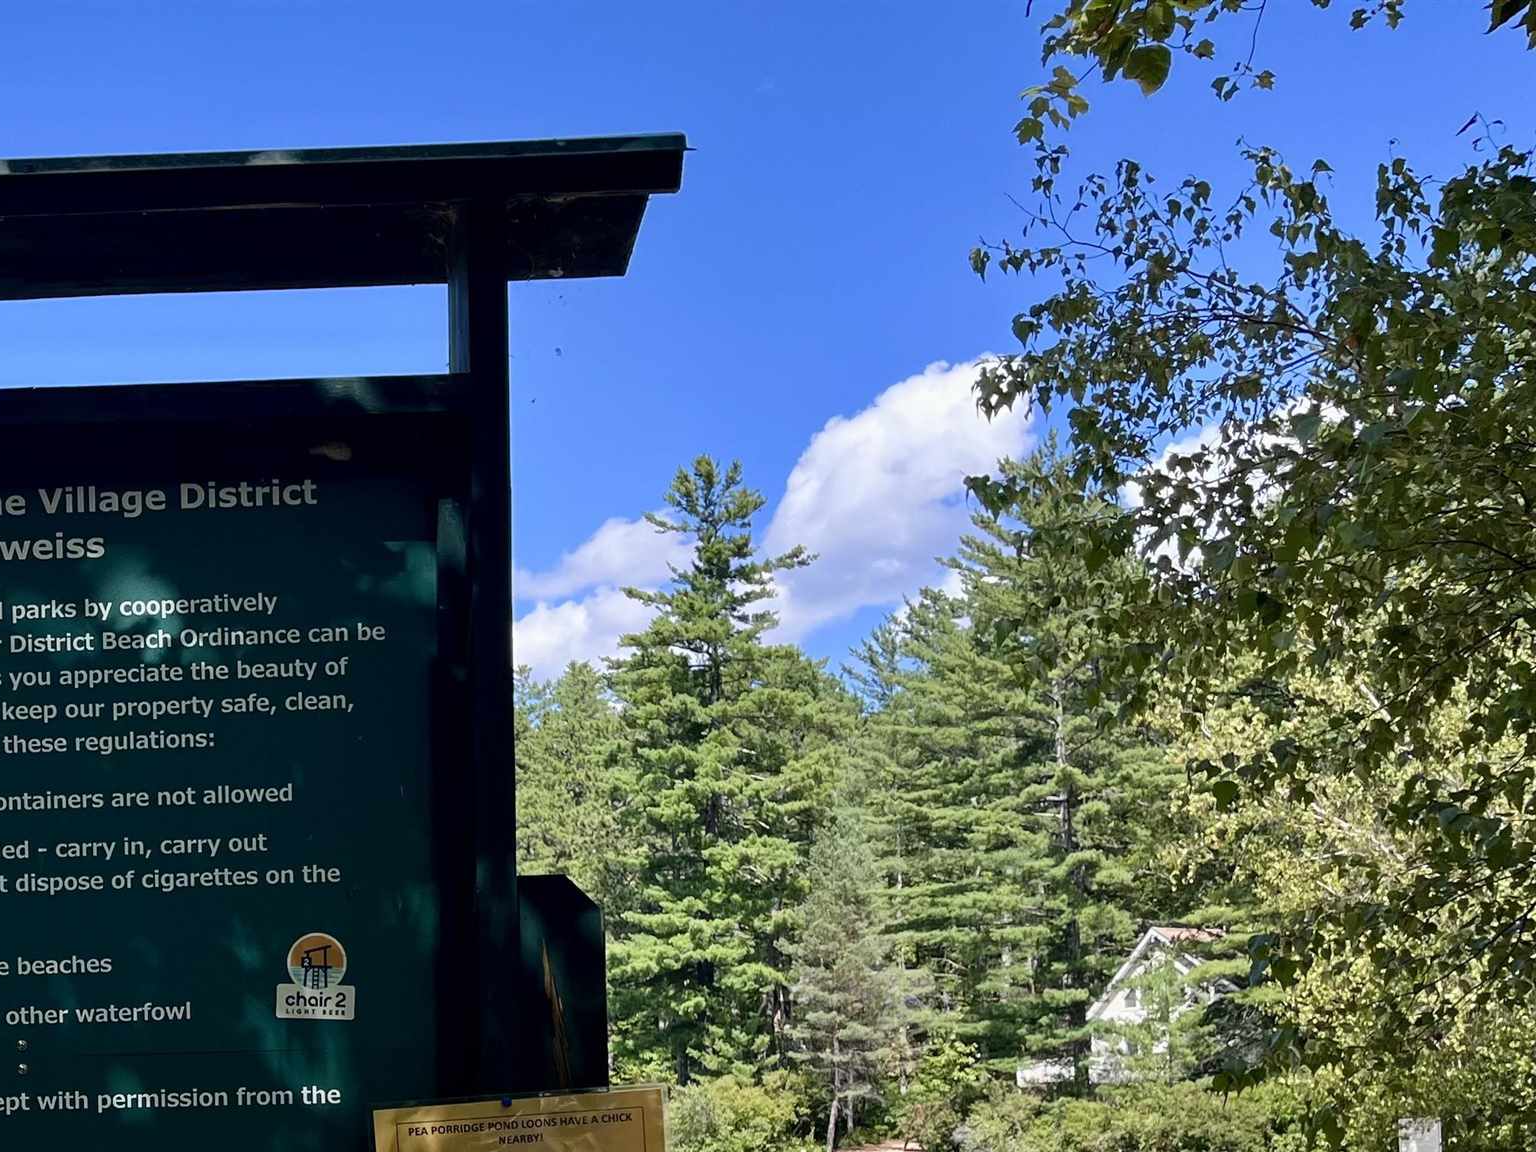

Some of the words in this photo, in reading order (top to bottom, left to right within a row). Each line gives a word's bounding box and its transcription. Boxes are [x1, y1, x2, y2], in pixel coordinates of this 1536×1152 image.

[37, 484, 166, 518] Village
[179, 477, 318, 510] District
[8, 670, 51, 691] you
[58, 662, 183, 689] appreciate
[189, 660, 229, 681] the
[236, 658, 317, 681] beauty
[324, 655, 349, 676] of
[110, 791, 149, 808] are
[156, 786, 196, 806] not
[202, 782, 293, 805] allowed
[16, 954, 112, 975] beaches
[285, 991, 332, 1007] chair
[335, 992, 346, 1008] 2
[408, 1126, 428, 1137] PEA
[431, 1122, 485, 1135] PORRIDGE
[488, 1119, 518, 1131] POND
[521, 1117, 557, 1129] LOONS
[560, 1115, 588, 1127] HAVE
[590, 1114, 599, 1124] A
[601, 1111, 633, 1123] CHICK
[498, 1133, 544, 1146] NEARBY!
